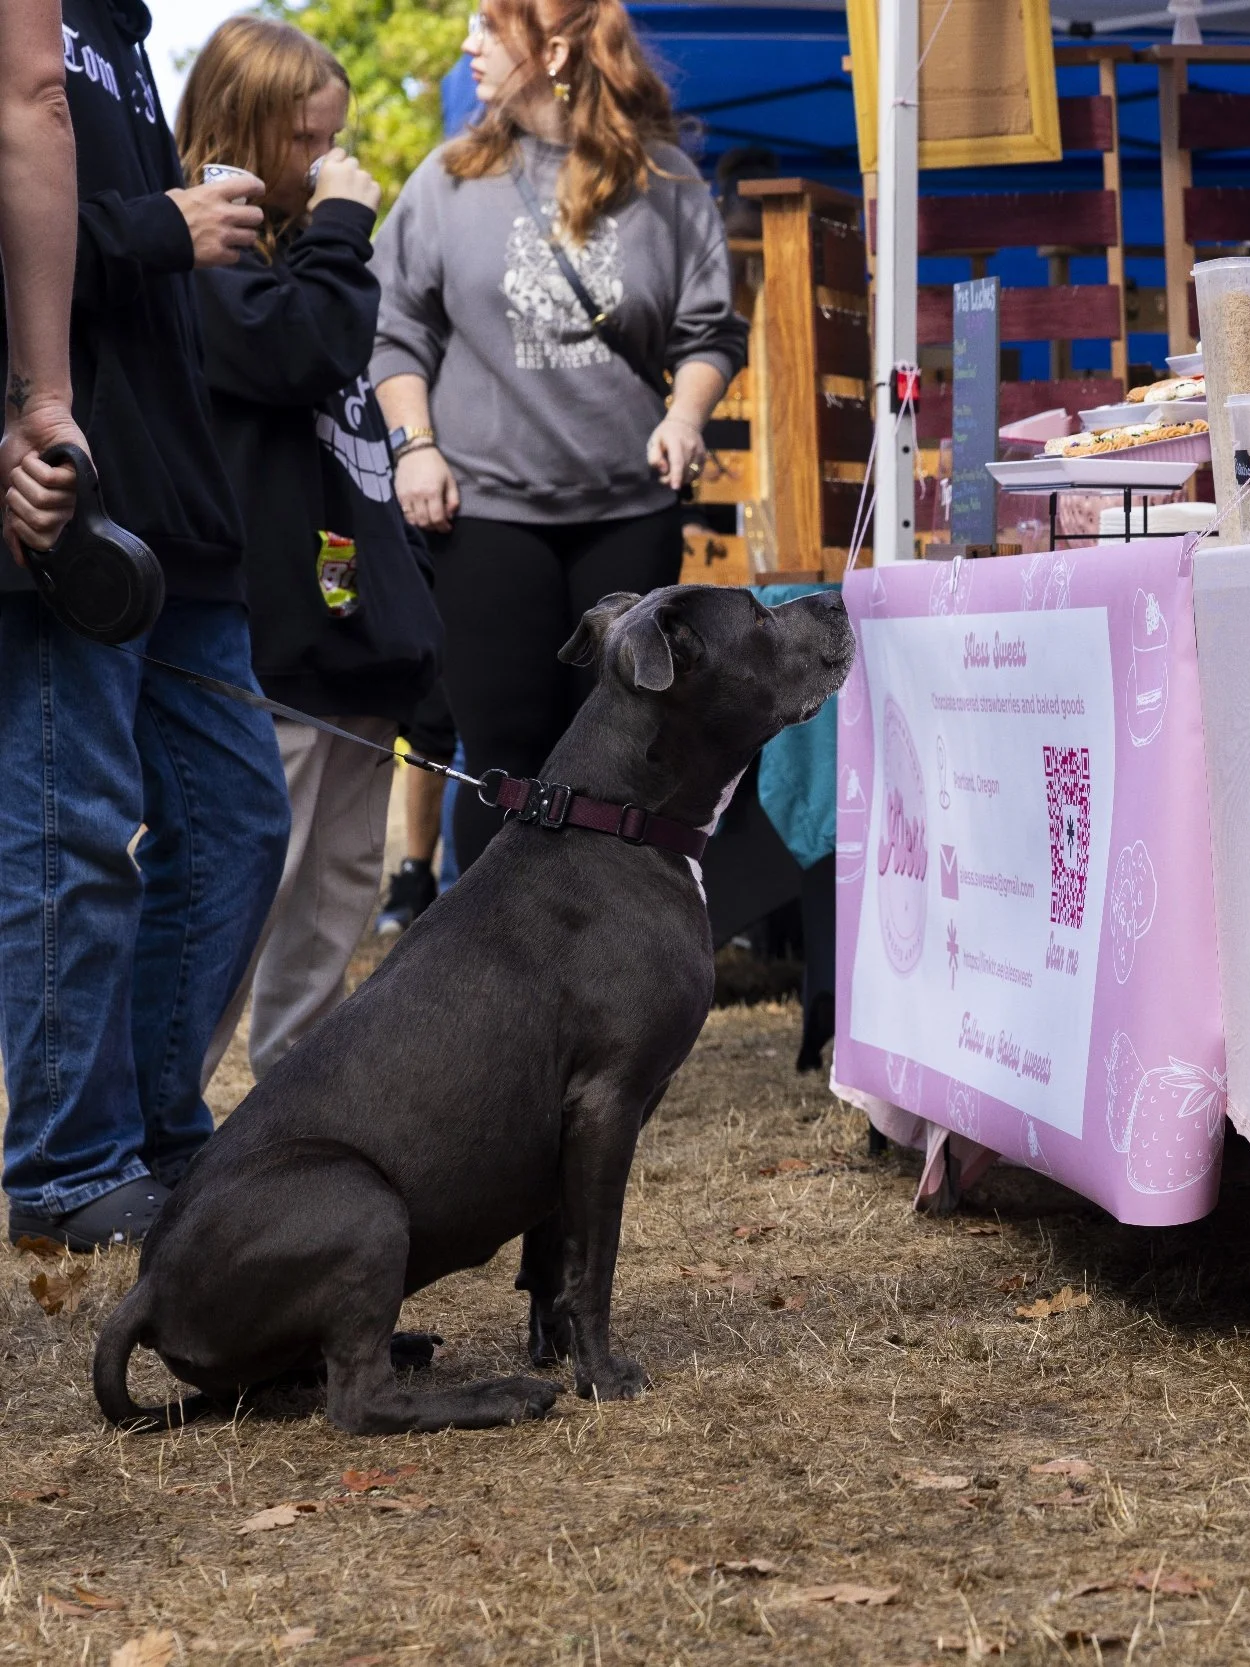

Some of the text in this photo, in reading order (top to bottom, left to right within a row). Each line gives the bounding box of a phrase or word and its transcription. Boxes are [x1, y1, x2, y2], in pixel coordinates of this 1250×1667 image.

[993, 629, 1027, 670] Sweets
[980, 693, 1021, 714] strawberries
[1021, 694, 1036, 714] and
[1035, 693, 1060, 715] baked
[1061, 694, 1085, 720] goods
[977, 775, 1000, 799] Oregon
[1045, 930, 1079, 977] Scan me
